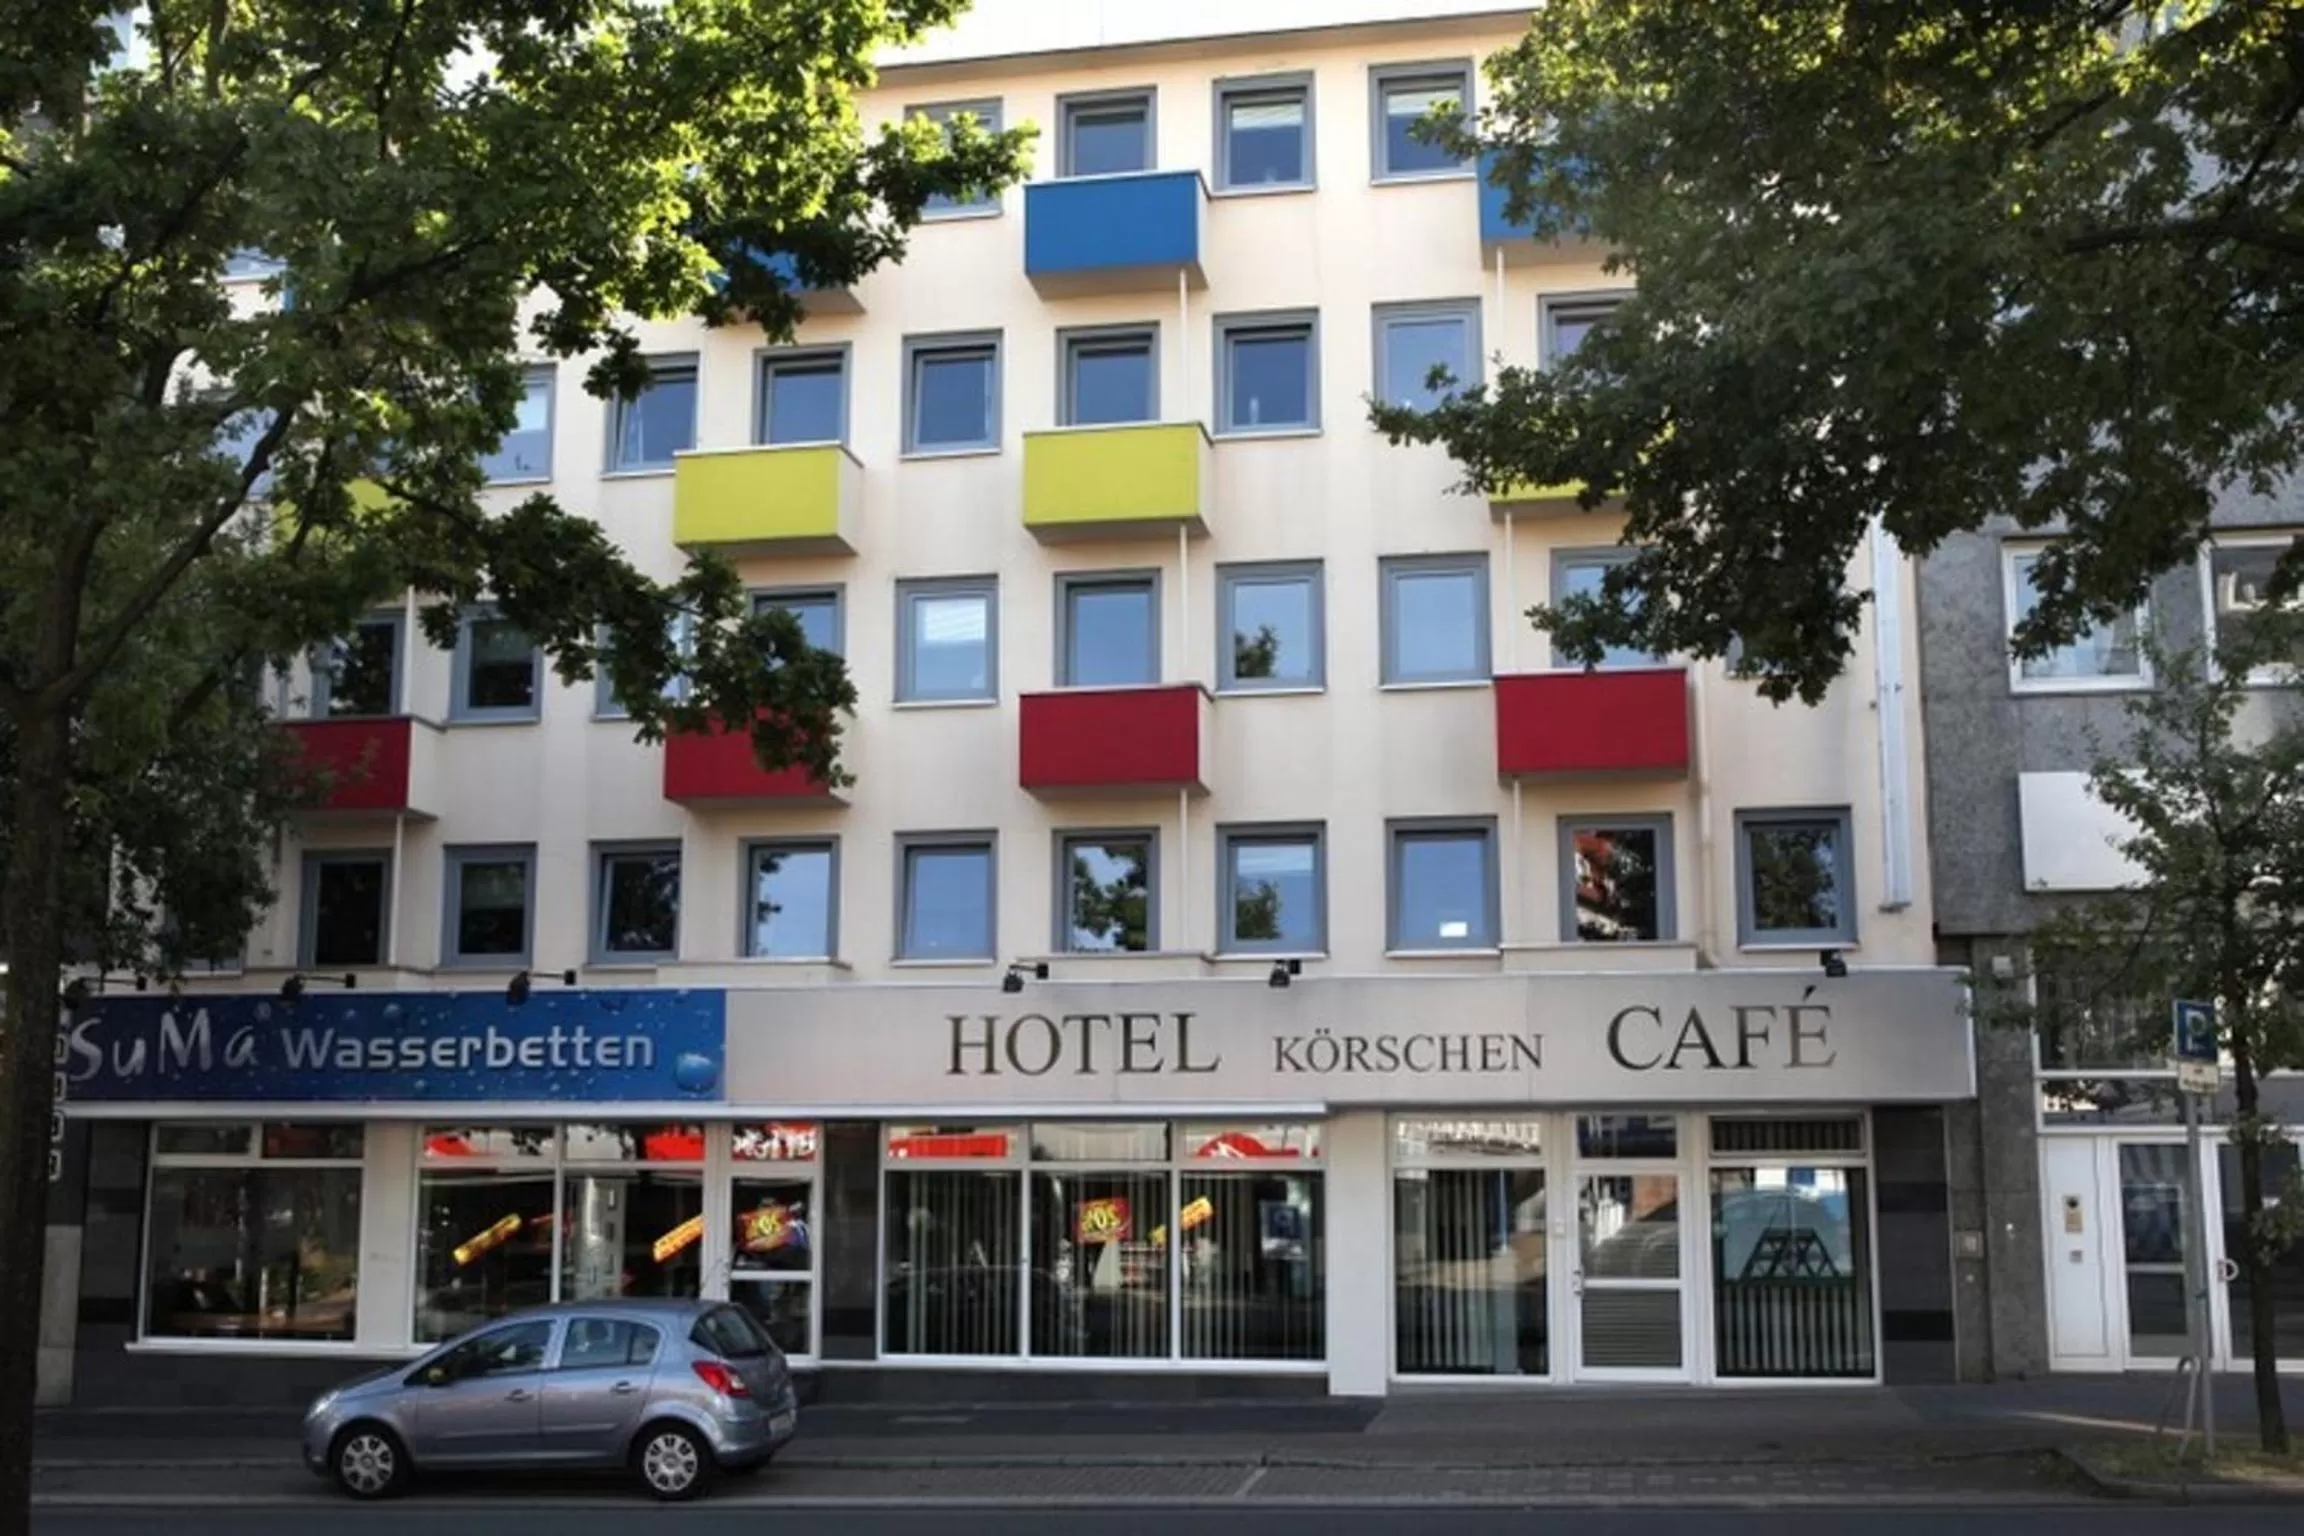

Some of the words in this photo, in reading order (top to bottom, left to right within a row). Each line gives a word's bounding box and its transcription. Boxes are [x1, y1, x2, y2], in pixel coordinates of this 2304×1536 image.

[69, 1007, 257, 1081] SuMa
[281, 1025, 654, 1069] Wasserbetten
[945, 1013, 1222, 1076] HOTEL
[1273, 1027, 1544, 1073] KÖRSCHEN
[1606, 984, 1837, 1071] CAFÉ
[2184, 1009, 2208, 1052] P
